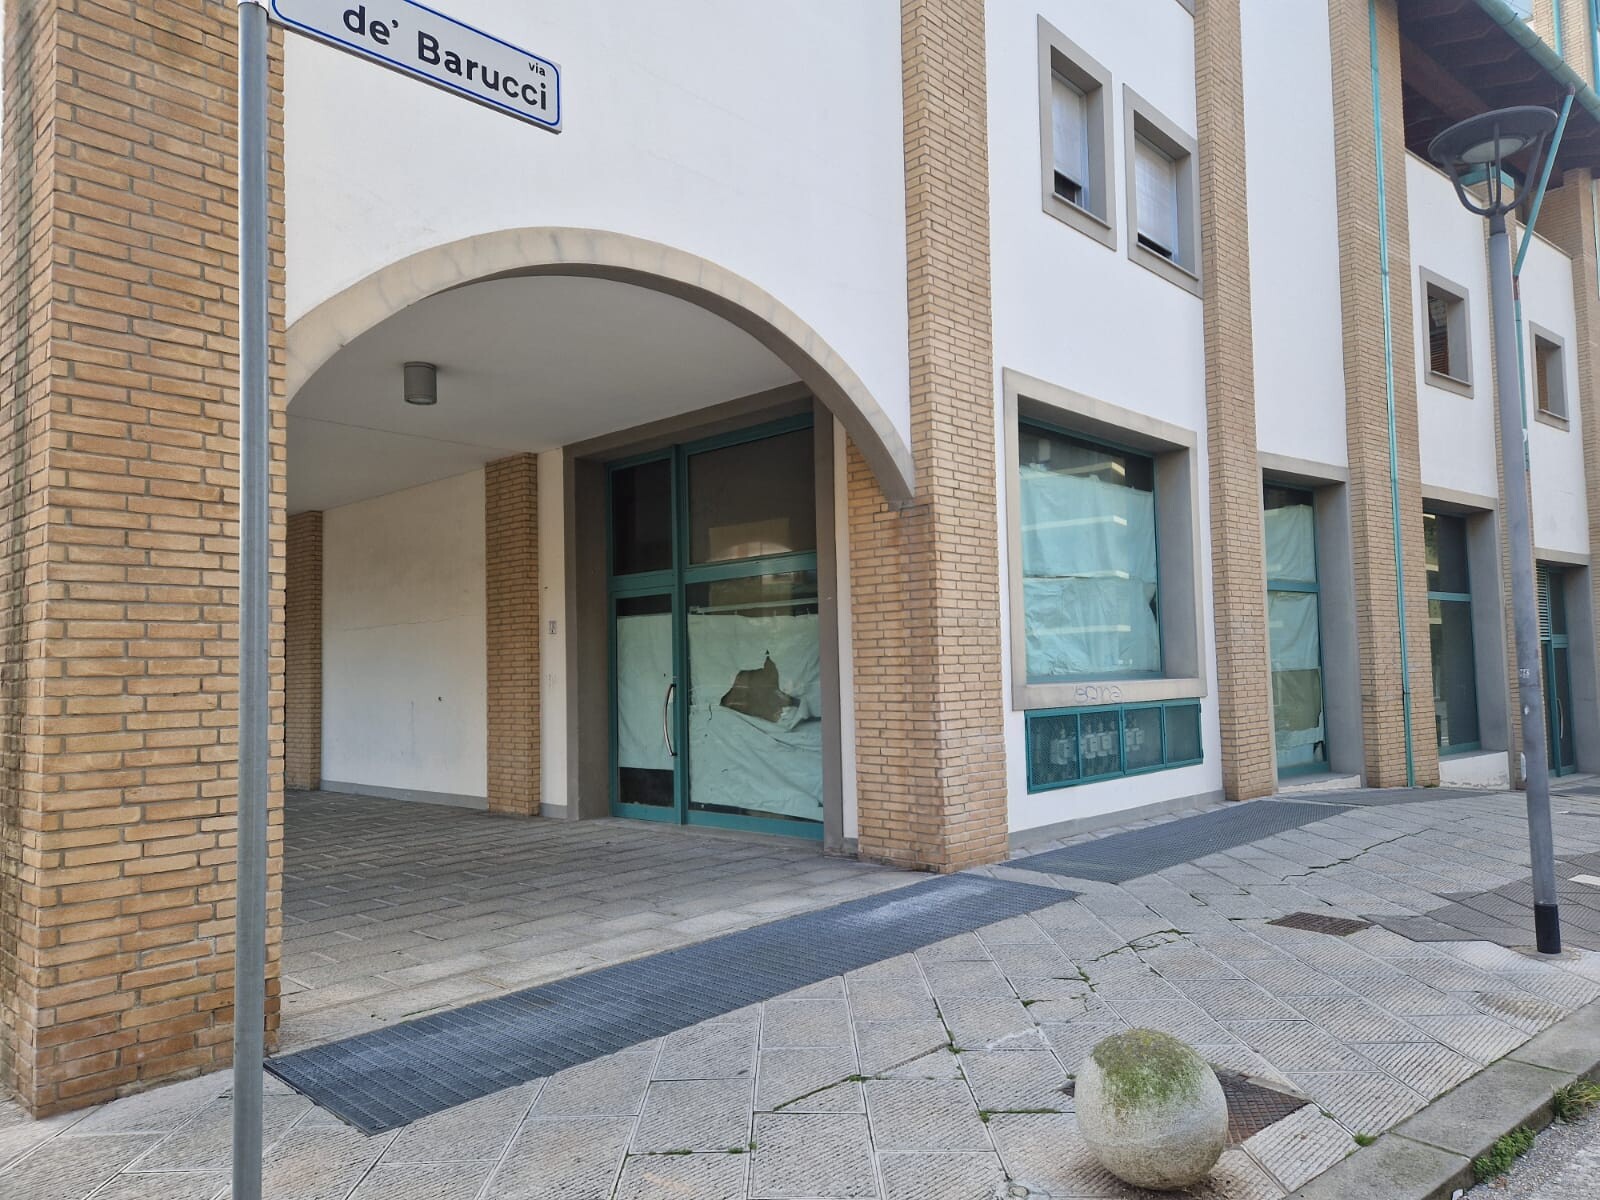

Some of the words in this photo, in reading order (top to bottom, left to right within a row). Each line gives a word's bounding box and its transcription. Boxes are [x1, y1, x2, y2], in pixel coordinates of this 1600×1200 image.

[343, 5, 399, 46] de'
[417, 30, 547, 111] Barucci
[528, 61, 546, 77] via
